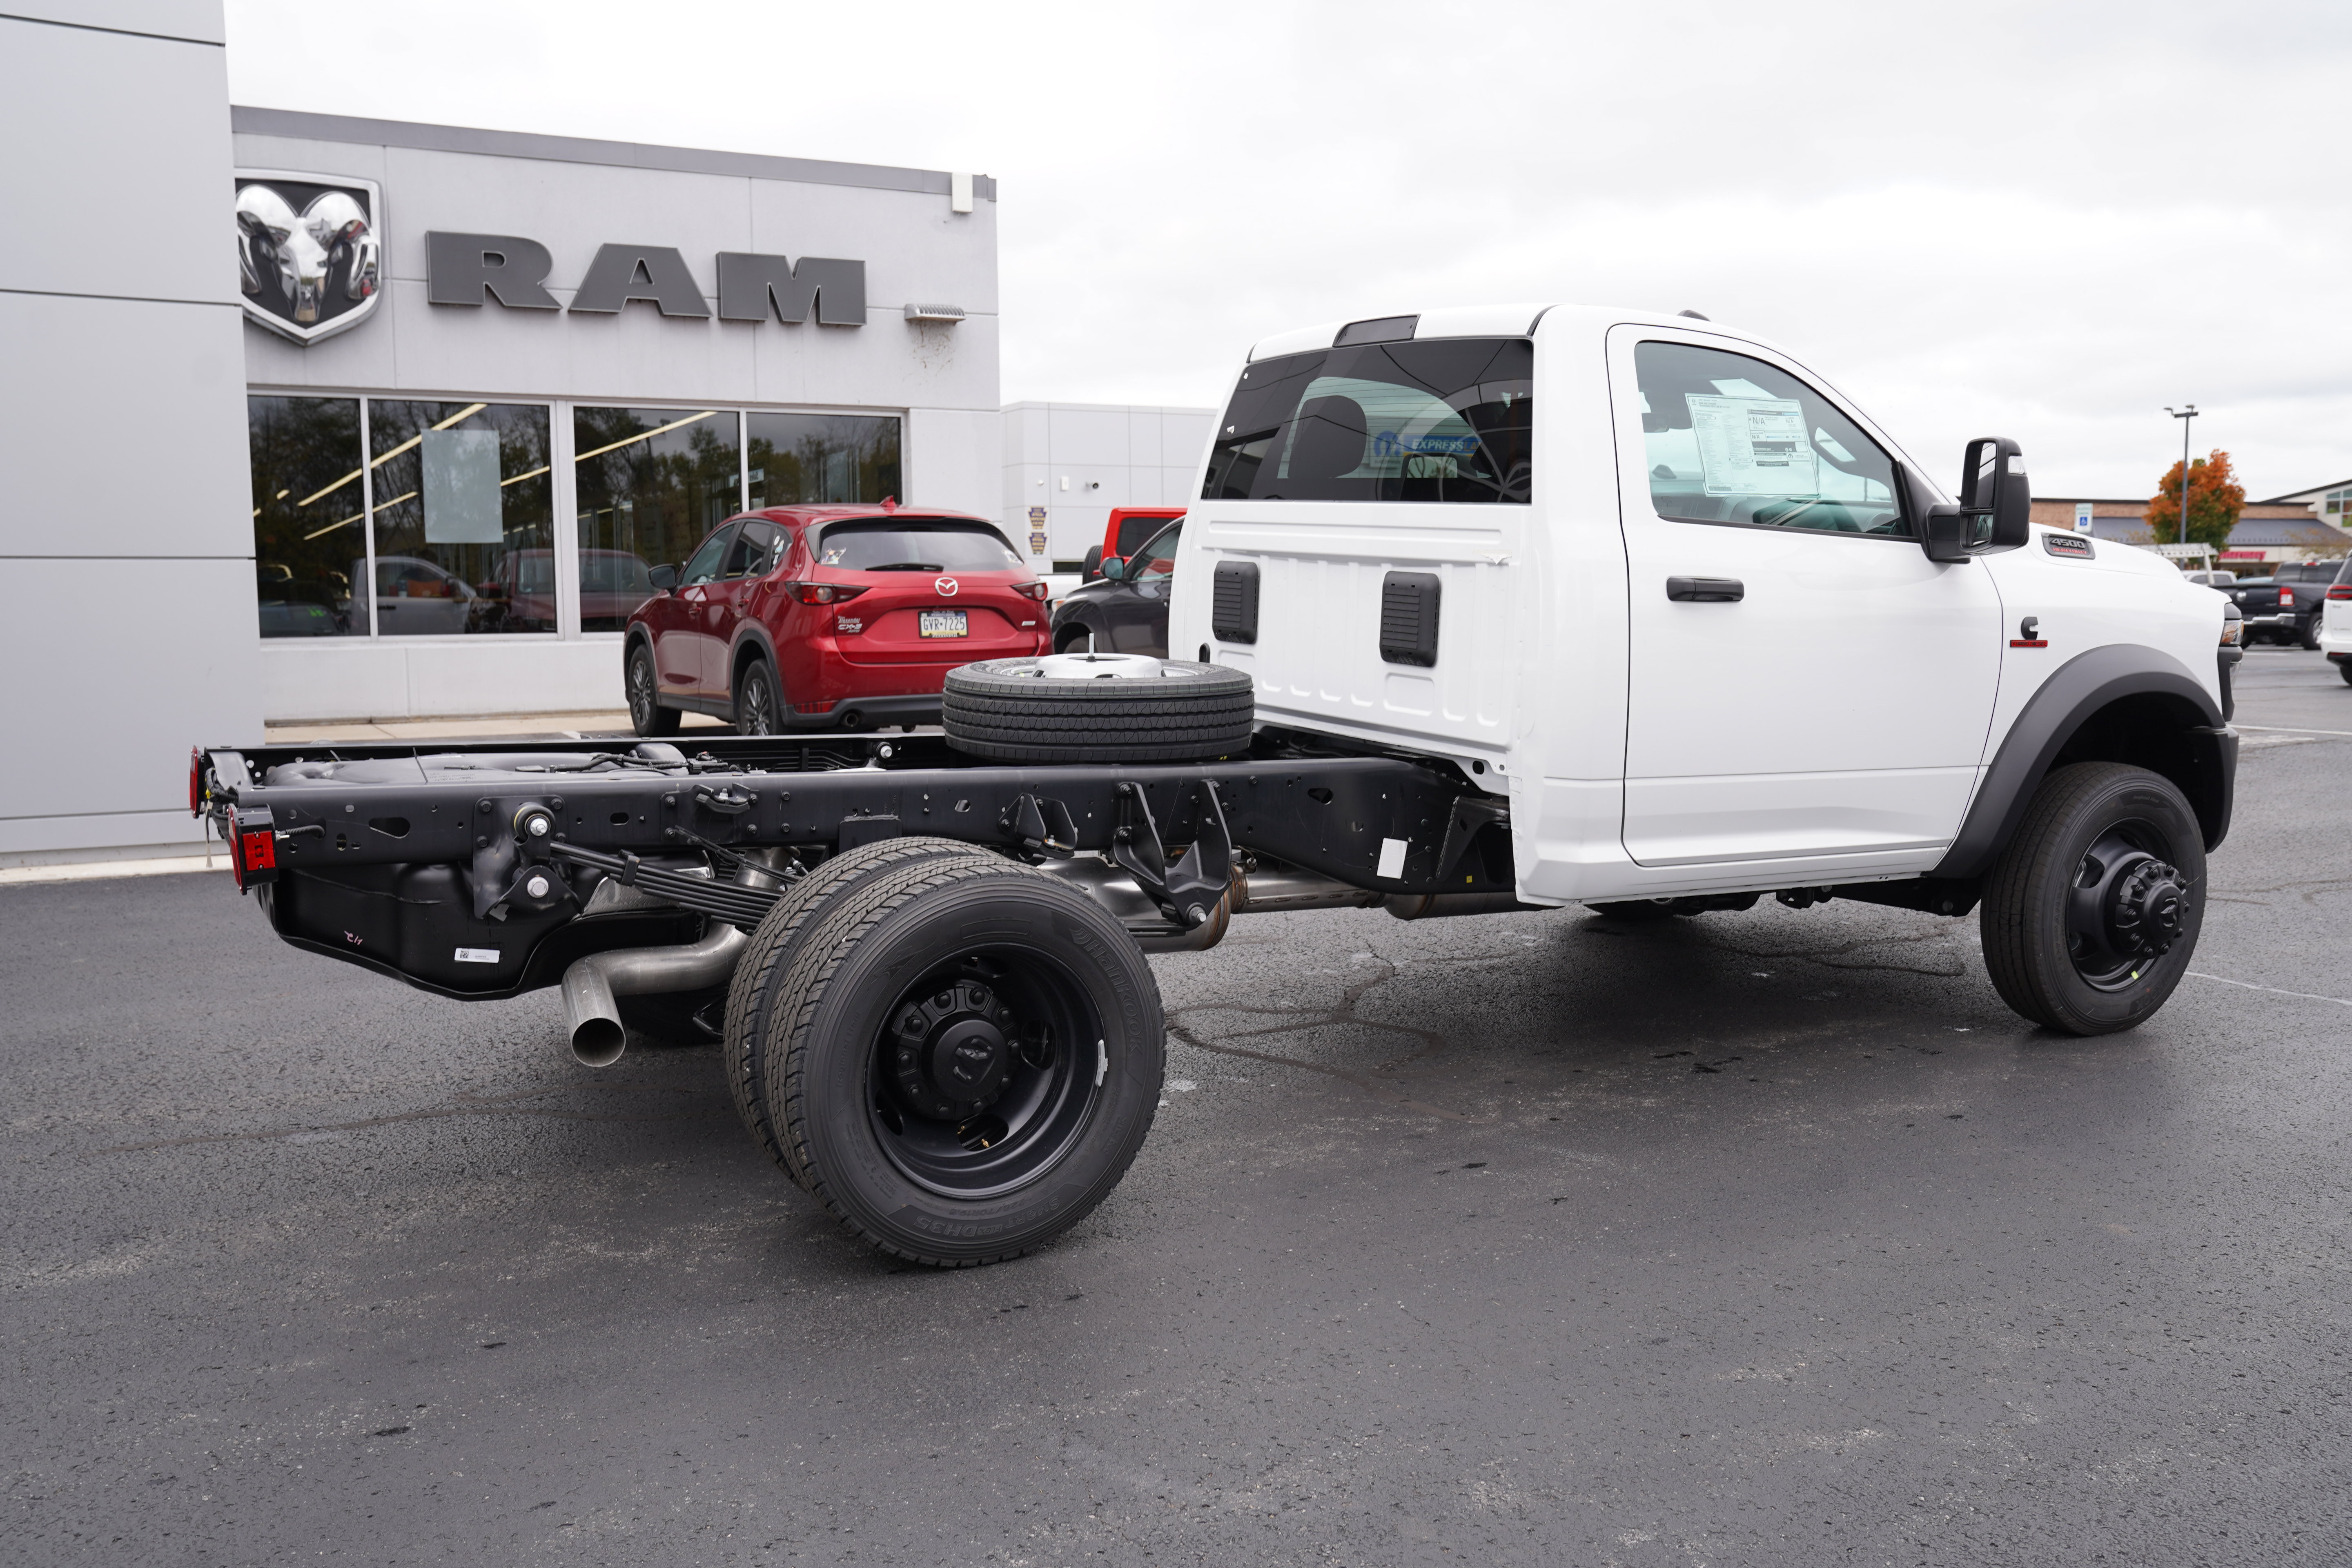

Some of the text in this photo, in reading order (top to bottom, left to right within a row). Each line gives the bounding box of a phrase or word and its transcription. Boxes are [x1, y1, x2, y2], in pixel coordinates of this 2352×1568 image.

[425, 231, 868, 327] RAM
[1752, 417, 1766, 425] N/A
[1411, 439, 1464, 451] EXPRESS
[2051, 538, 2085, 548] 4500
